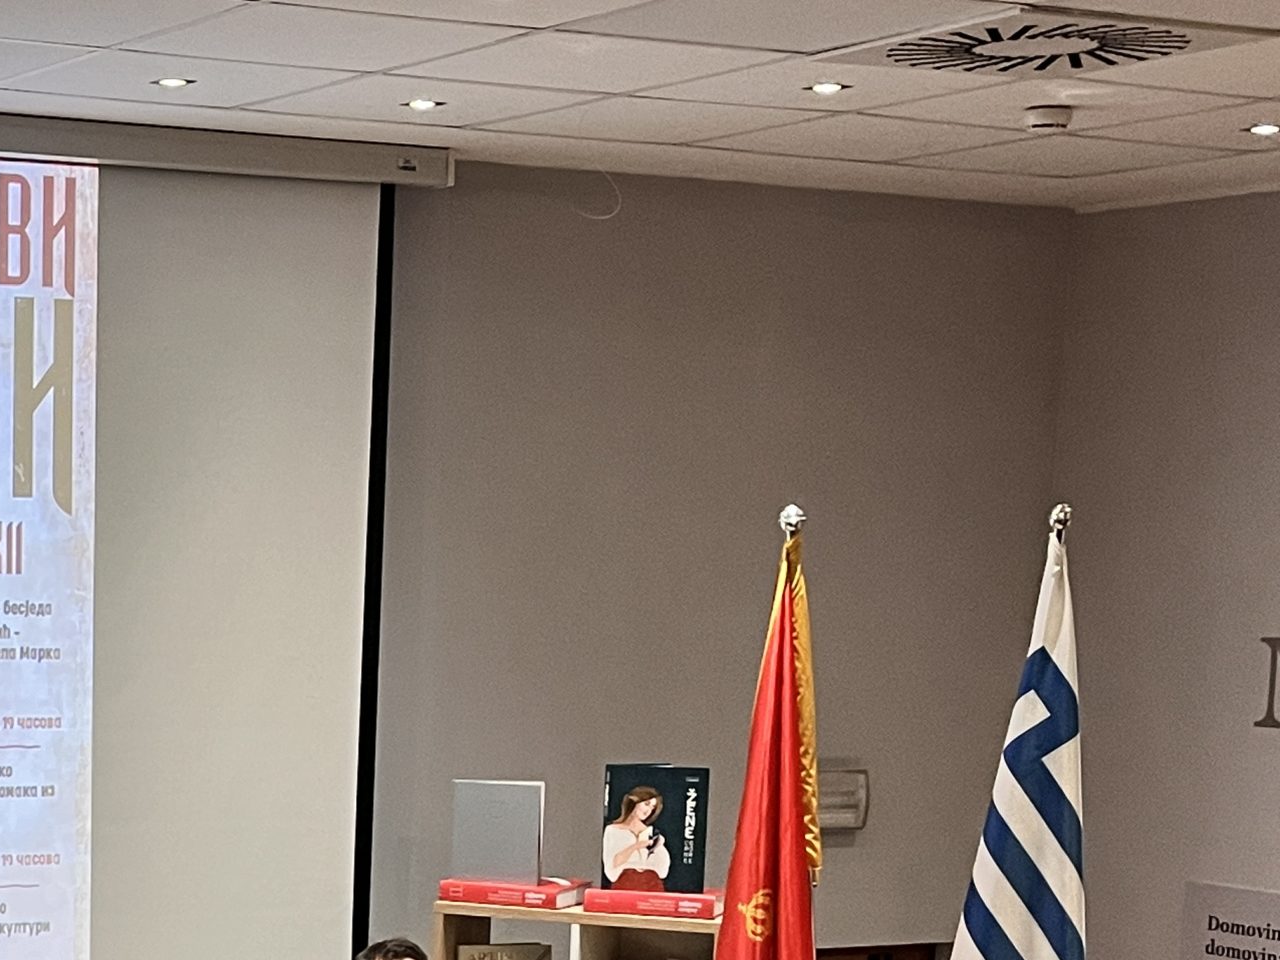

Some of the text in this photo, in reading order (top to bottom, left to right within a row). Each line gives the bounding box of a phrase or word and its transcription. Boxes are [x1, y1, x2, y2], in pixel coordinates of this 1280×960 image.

[3, 599, 53, 617] бесједа
[19, 646, 61, 663] Марка
[17, 717, 62, 729] часова
[684, 788, 697, 839] ŽENE
[16, 853, 61, 866] часова
